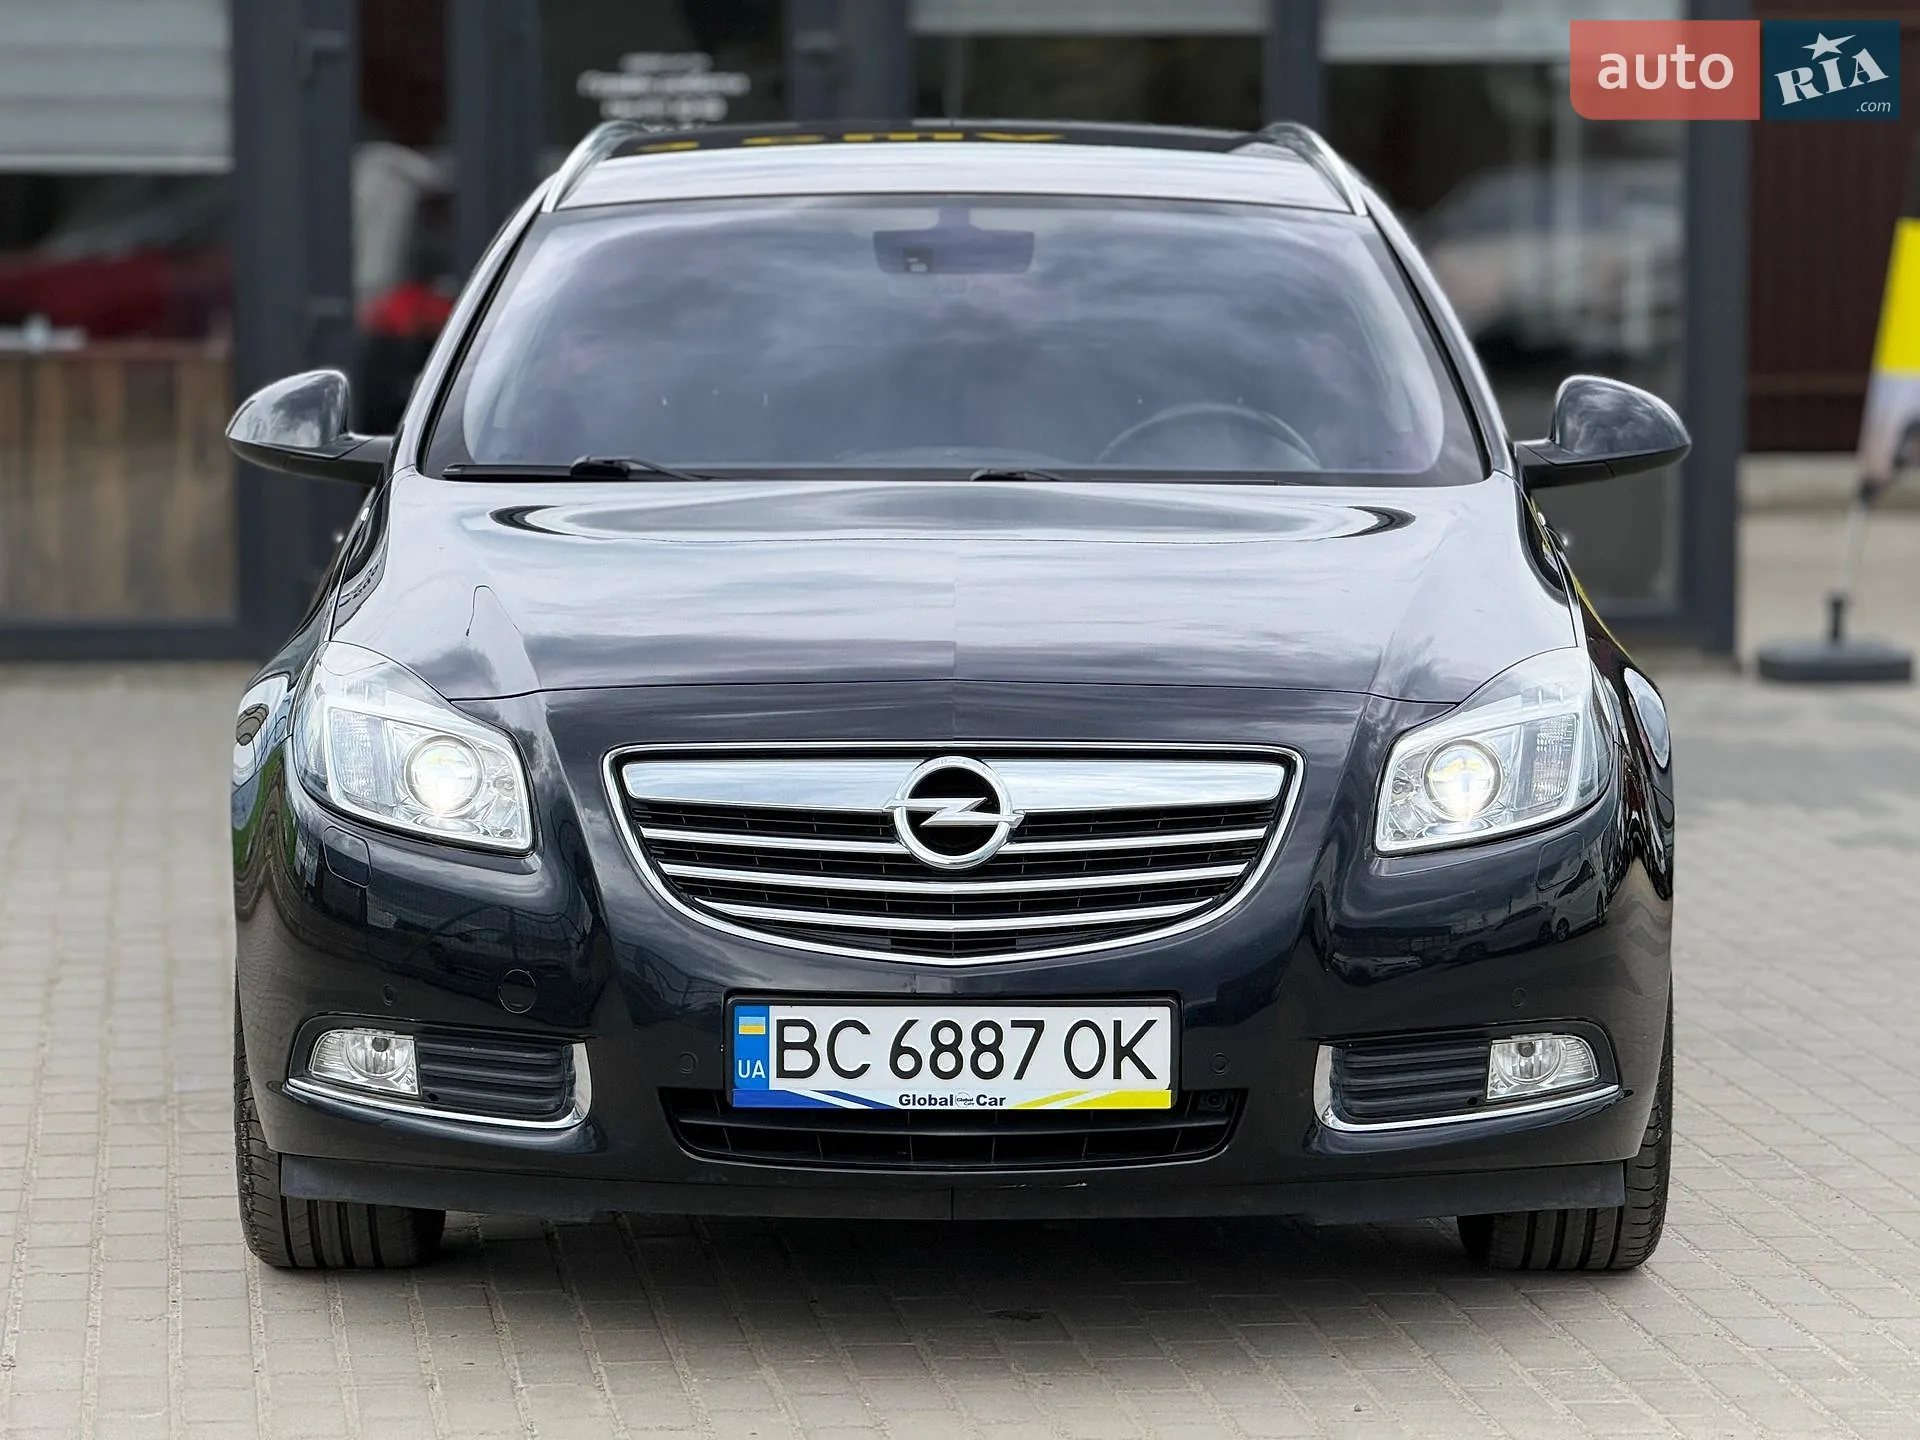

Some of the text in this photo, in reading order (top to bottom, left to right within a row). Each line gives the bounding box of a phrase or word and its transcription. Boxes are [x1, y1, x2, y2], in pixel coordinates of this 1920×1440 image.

[775, 1019, 1159, 1080] BC 6887 OK
[738, 1059, 766, 1079] UA
[898, 1093, 953, 1107] Global
[976, 1093, 1007, 1107] Car
